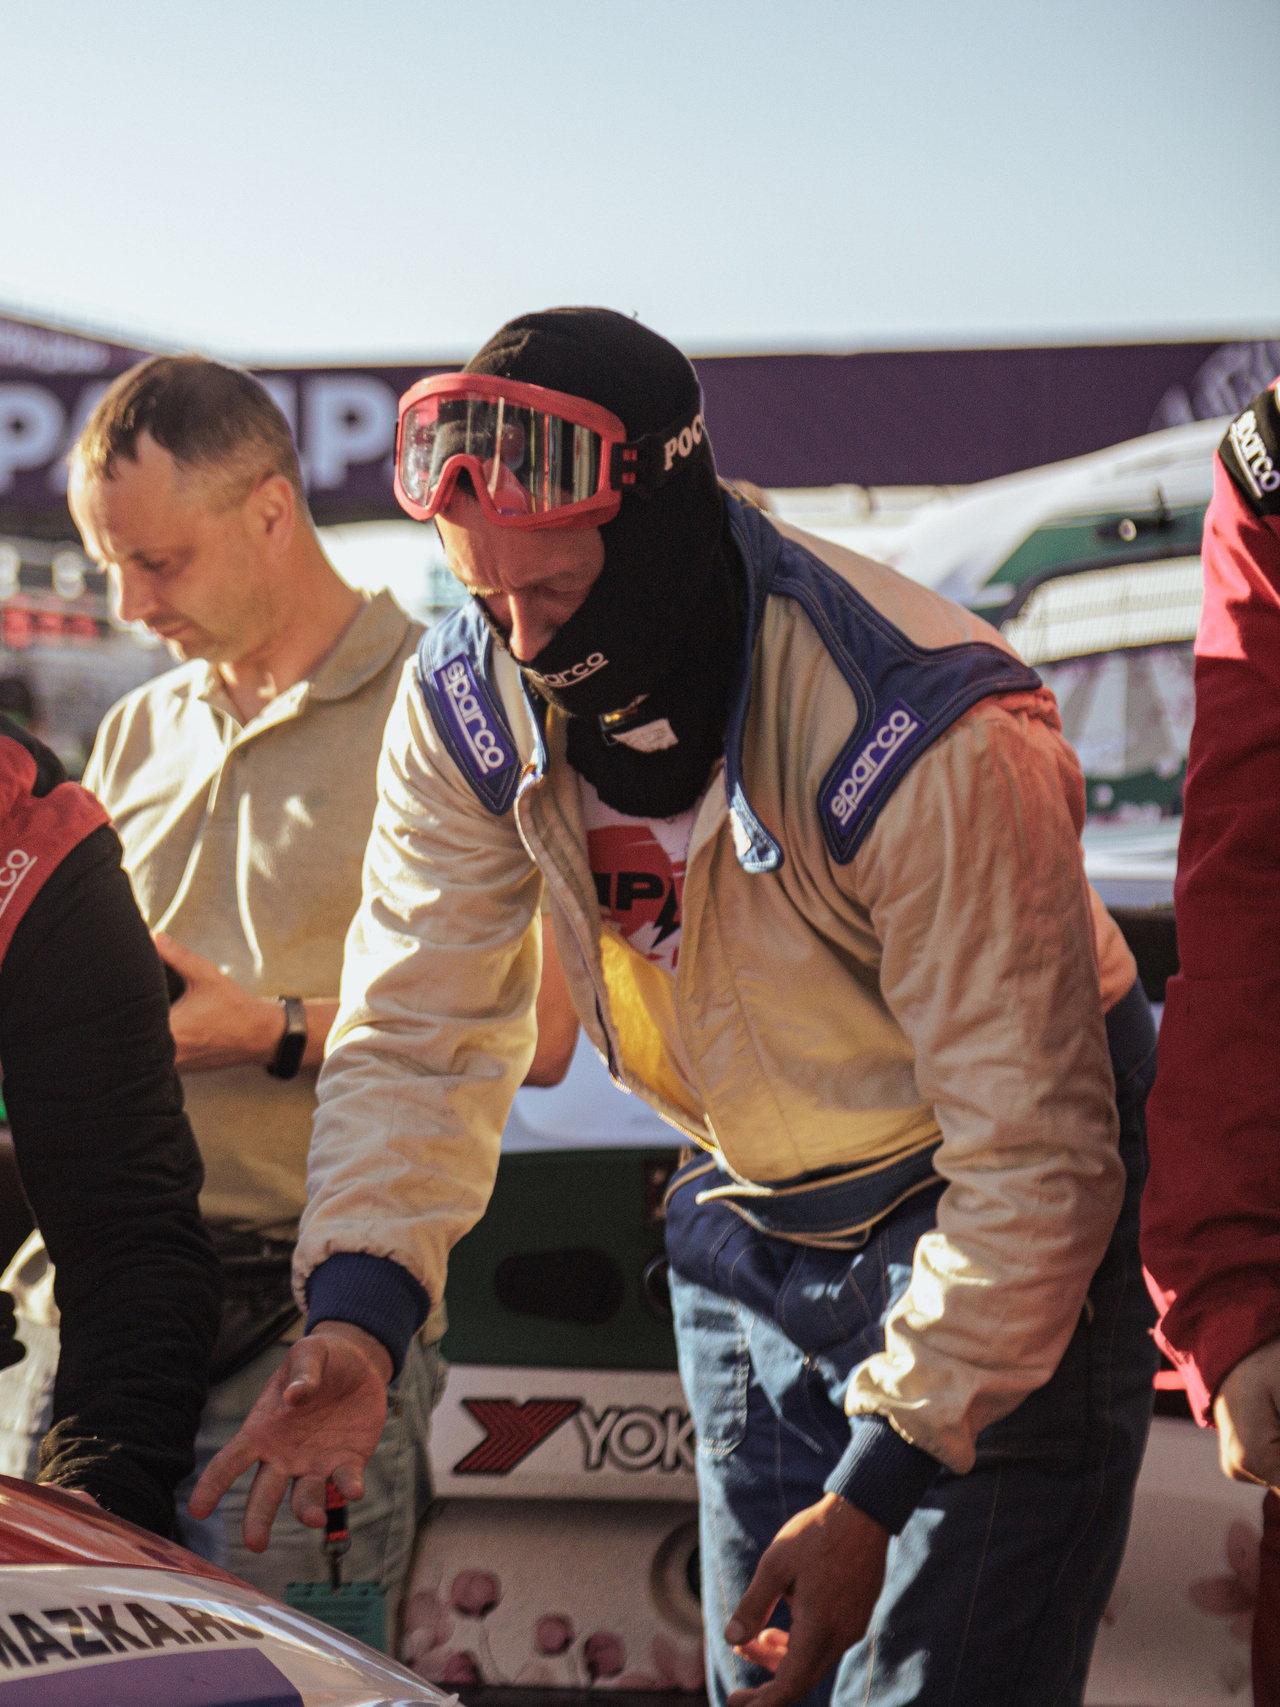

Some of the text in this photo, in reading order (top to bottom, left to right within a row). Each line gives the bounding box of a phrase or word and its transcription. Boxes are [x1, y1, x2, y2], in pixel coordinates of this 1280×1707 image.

[441, 661, 505, 774] sparco
[523, 651, 609, 690] arco
[831, 710, 918, 826] sparco
